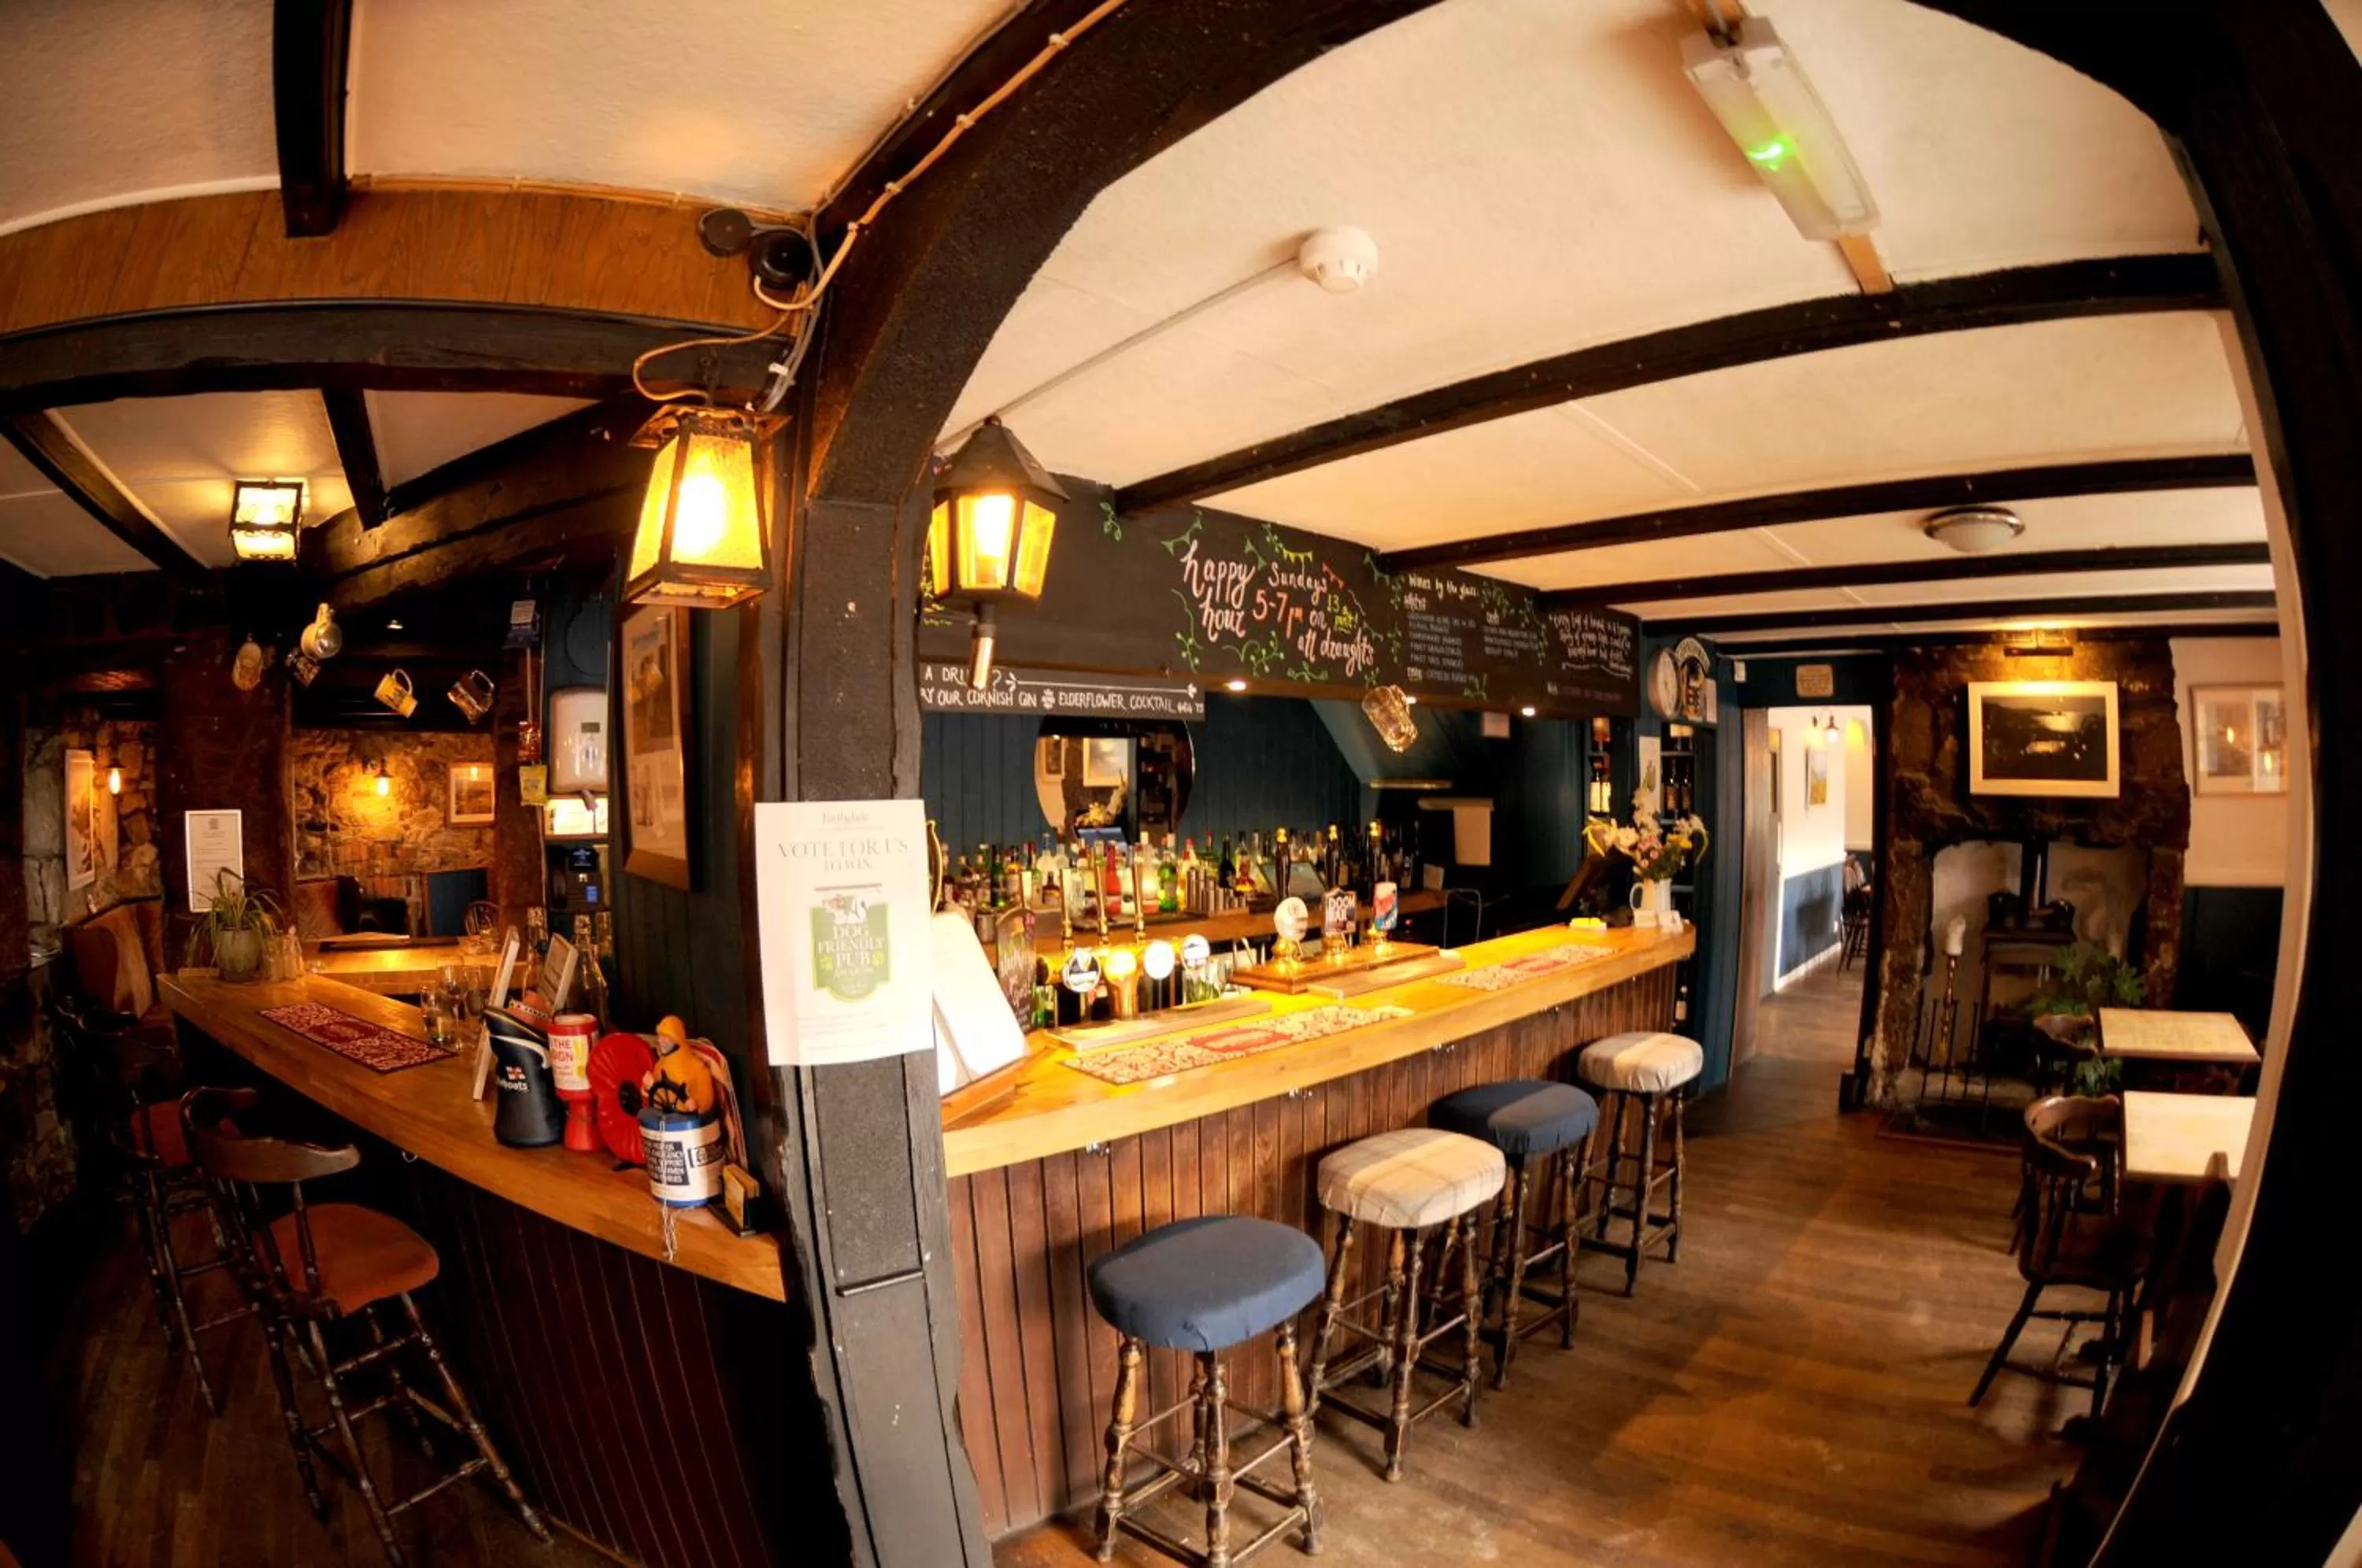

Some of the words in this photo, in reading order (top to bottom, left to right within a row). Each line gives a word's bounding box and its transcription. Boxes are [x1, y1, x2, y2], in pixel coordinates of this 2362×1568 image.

[1180, 539, 1255, 608] happy
[1268, 562, 1328, 605] Sundays
[1199, 586, 1246, 642] hour
[1309, 609, 1327, 629] on
[1320, 629, 1375, 677] draughts
[925, 665, 933, 680] A
[942, 666, 1002, 691] DRI?
[937, 689, 964, 706] OUR
[1058, 691, 1127, 712] ELDERFLOWER
[1130, 694, 1176, 713] COCKTAIL
[778, 839, 834, 859] VOTE
[839, 838, 881, 858] FOR
[884, 836, 909, 855] US
[824, 859, 842, 873] TO
[844, 857, 872, 871] WIN
[833, 924, 870, 939] DOG
[818, 935, 886, 954] FRIENDLY
[836, 950, 870, 969] PUB
